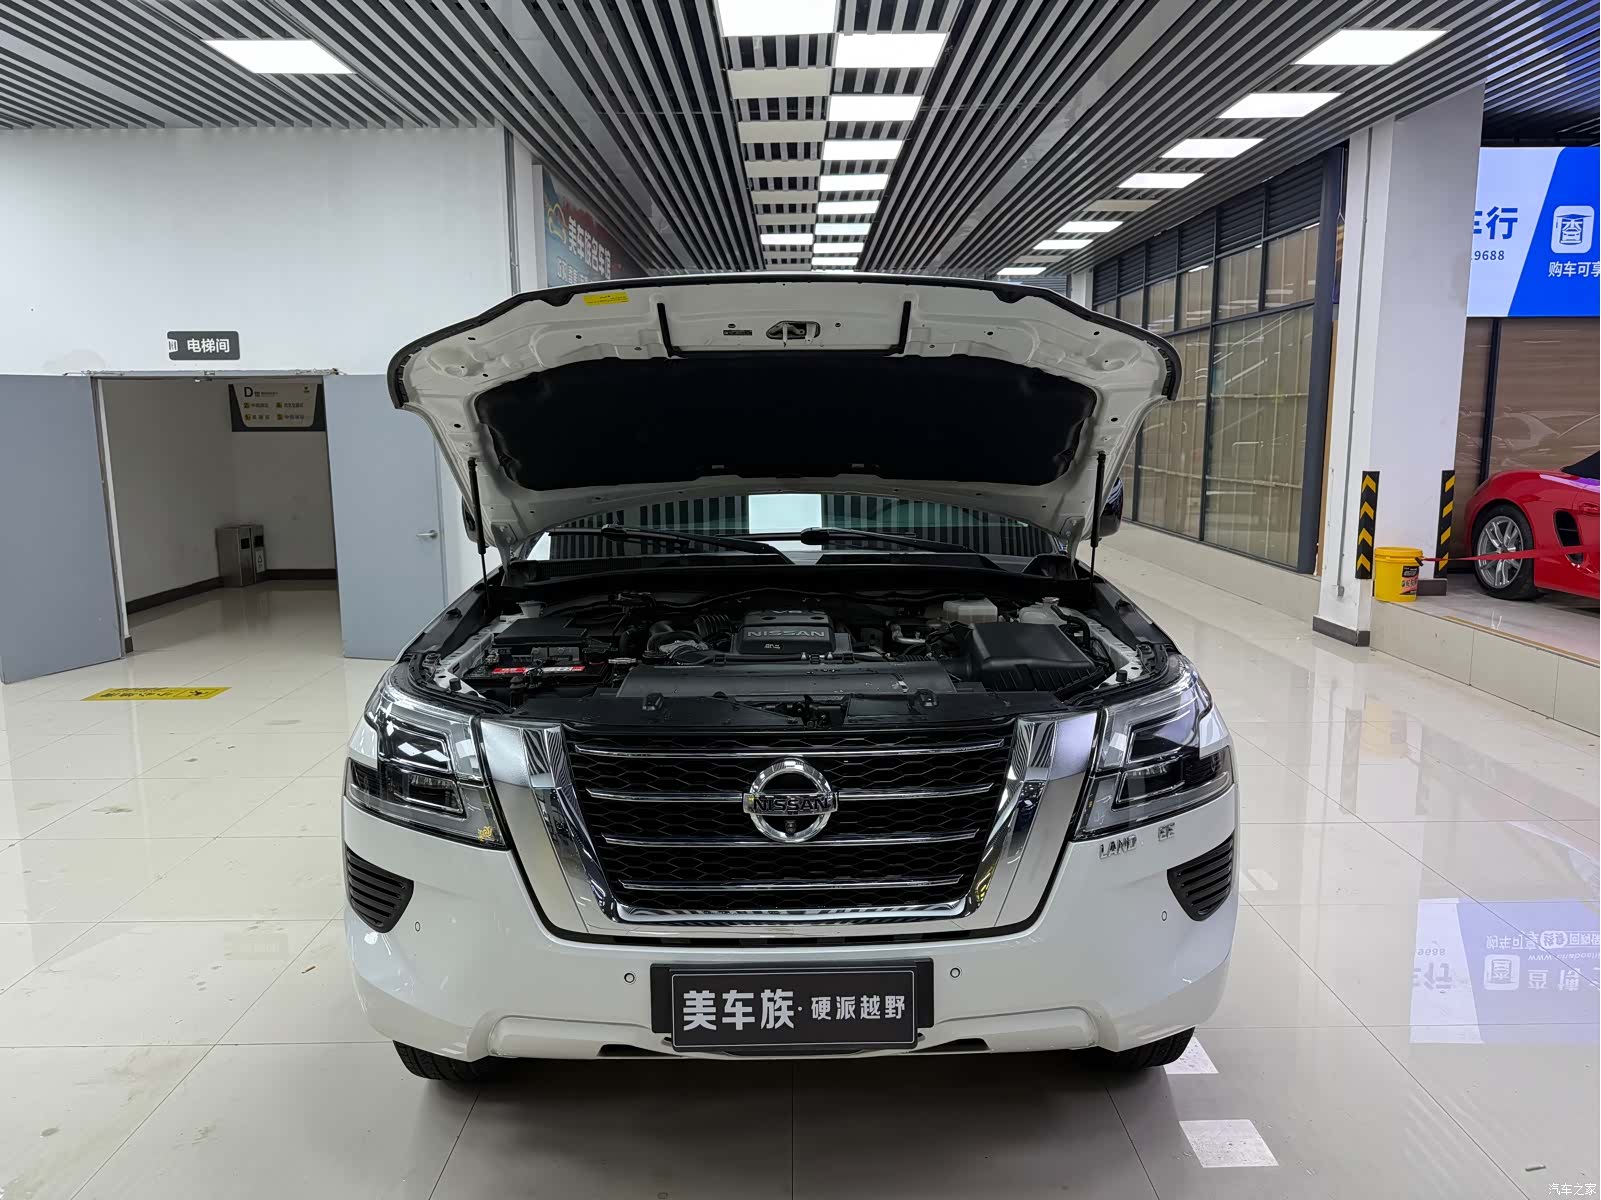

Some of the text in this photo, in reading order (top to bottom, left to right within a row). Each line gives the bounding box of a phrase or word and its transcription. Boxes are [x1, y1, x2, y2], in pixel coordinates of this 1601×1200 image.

[1472, 250, 1505, 261] 9688
[187, 338, 230, 353] 电梯间
[244, 386, 253, 398] D
[752, 798, 829, 811] NISSAN
[1100, 834, 1137, 859] LAND
